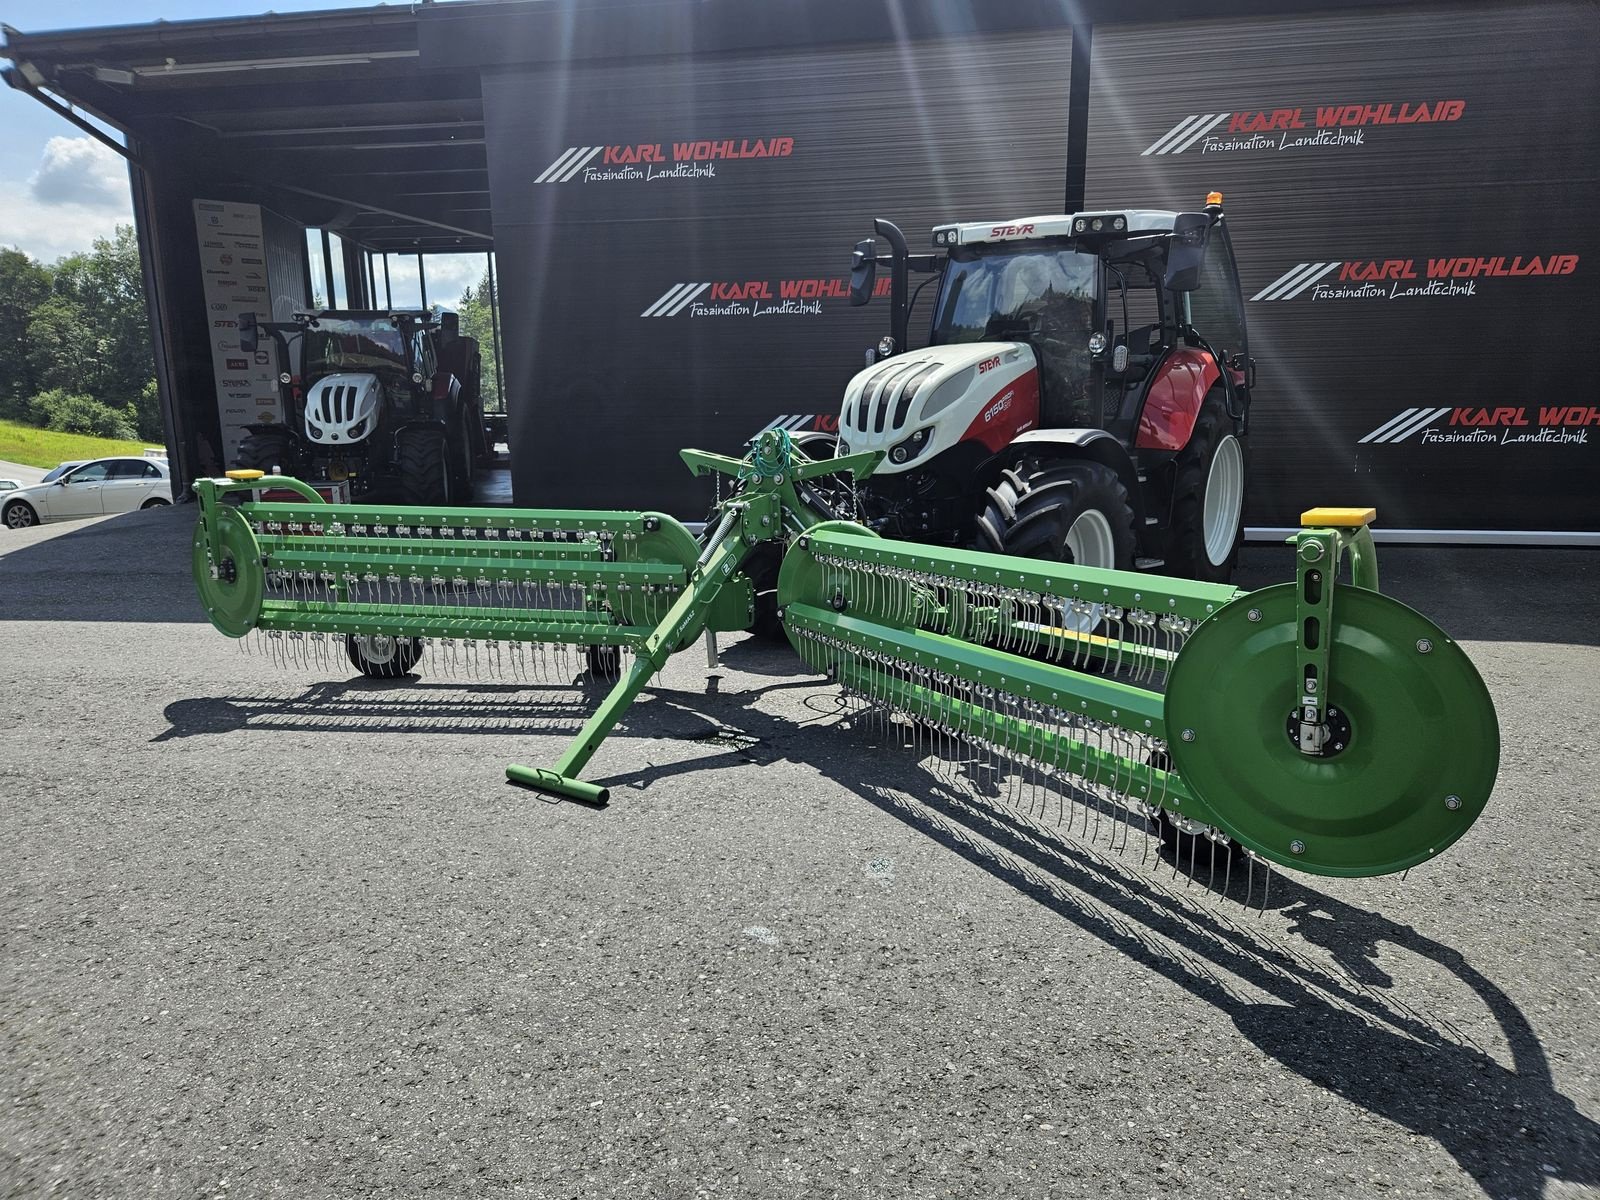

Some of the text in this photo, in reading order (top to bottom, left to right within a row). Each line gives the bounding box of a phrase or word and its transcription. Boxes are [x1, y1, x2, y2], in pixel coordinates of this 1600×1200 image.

[1228, 107, 1306, 133] KARL
[1201, 128, 1365, 154] Faszination Landtechnik
[603, 143, 666, 164] KARL
[583, 162, 716, 183] Faszination Landtechnik
[990, 224, 1035, 238] STEYR
[1338, 259, 1416, 281] KARL
[710, 280, 774, 300] KARL
[1311, 278, 1477, 301] Faszination Landtechnik
[690, 299, 823, 318] Faszination Landtechnik
[214, 320, 239, 328] STEY
[978, 356, 1001, 375] STEYR
[984, 398, 1004, 423] 6150
[1449, 407, 1530, 426] KARL
[1421, 426, 1588, 446] Faszination Landtechnik
